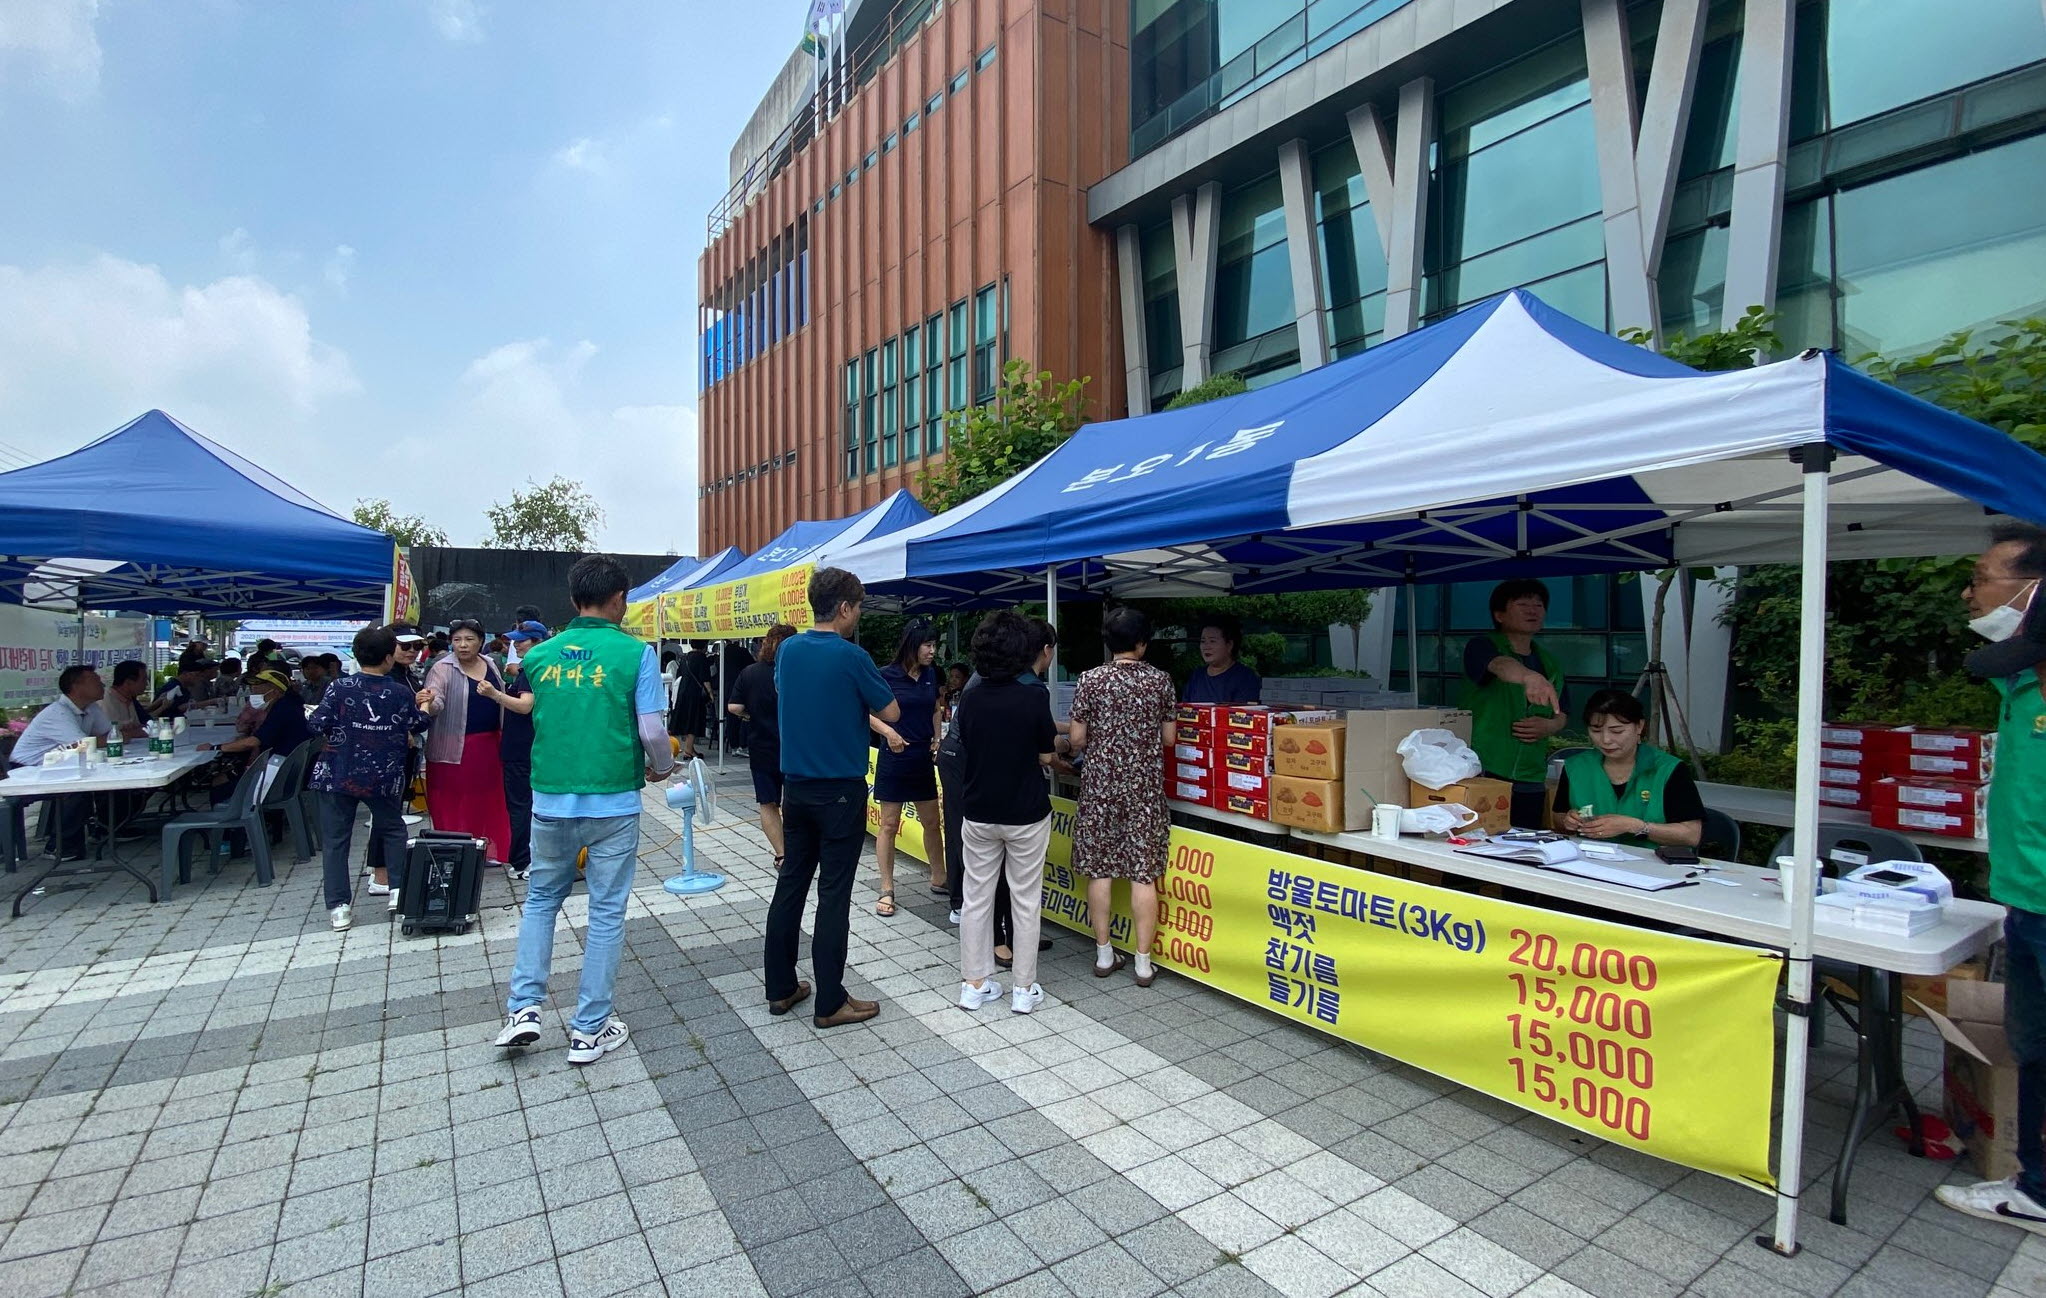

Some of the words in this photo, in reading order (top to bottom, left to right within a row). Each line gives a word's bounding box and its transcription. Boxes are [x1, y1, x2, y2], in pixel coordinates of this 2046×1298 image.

[1060, 420, 1285, 493] 본오1동
[778, 588, 806, 608] 10,000원
[540, 663, 607, 687] 새마을
[560, 648, 593, 660] SMU
[1267, 903, 1316, 944] 액젓
[1507, 973, 1652, 1040] 15,000
[1268, 868, 1486, 954] 방울토마토(3Kg)
[1508, 928, 1657, 991] 20,000
[1264, 937, 1340, 988] 참기름
[1506, 1014, 1653, 1089] 15,000
[1266, 971, 1341, 1025] 들기름
[1508, 1057, 1651, 1141] 15,000
